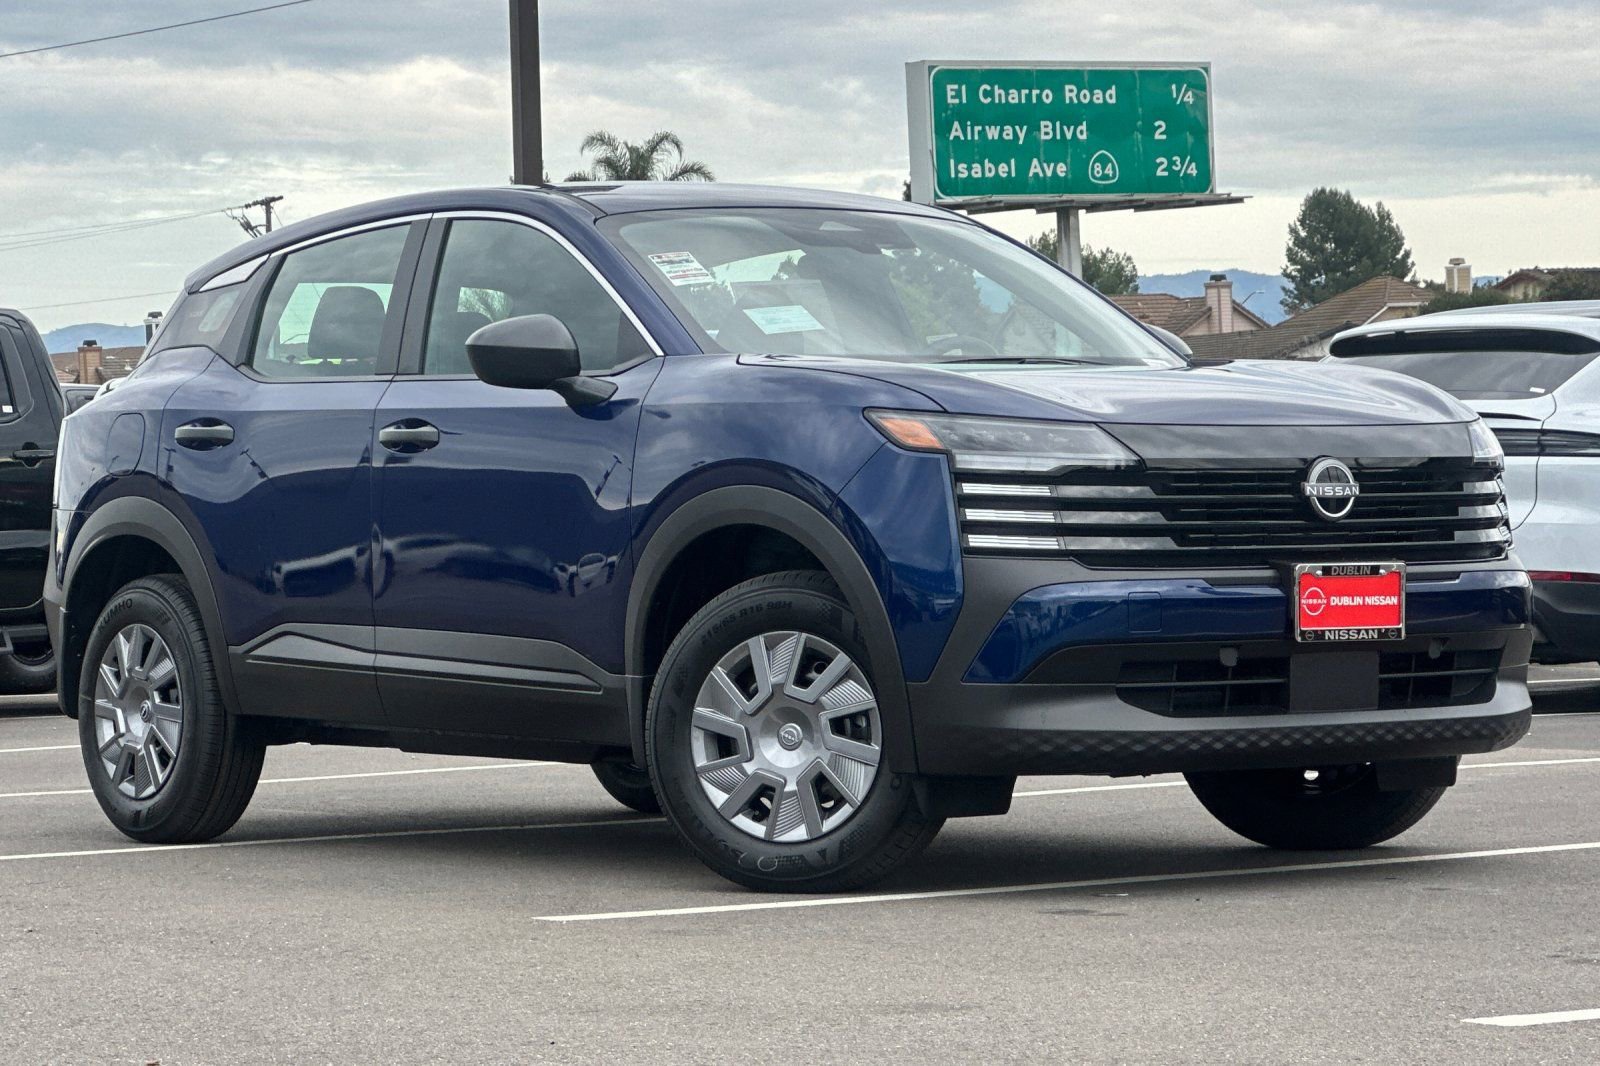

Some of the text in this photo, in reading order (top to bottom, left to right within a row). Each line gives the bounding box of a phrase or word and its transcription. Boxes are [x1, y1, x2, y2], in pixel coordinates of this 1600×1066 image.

[946, 84, 967, 104] El
[978, 84, 1053, 104] Charro
[1064, 84, 1117, 104] Road
[949, 120, 1167, 145] Airway Blvd 2
[950, 158, 1016, 178] Isabel
[1028, 158, 1068, 178] Ave
[1093, 162, 1114, 177] 84
[1305, 486, 1360, 496] NISSAN
[1331, 565, 1371, 576] DUBLIN
[1330, 595, 1398, 606] DUBLIN NISSAN
[1324, 628, 1378, 640] NISSAN
